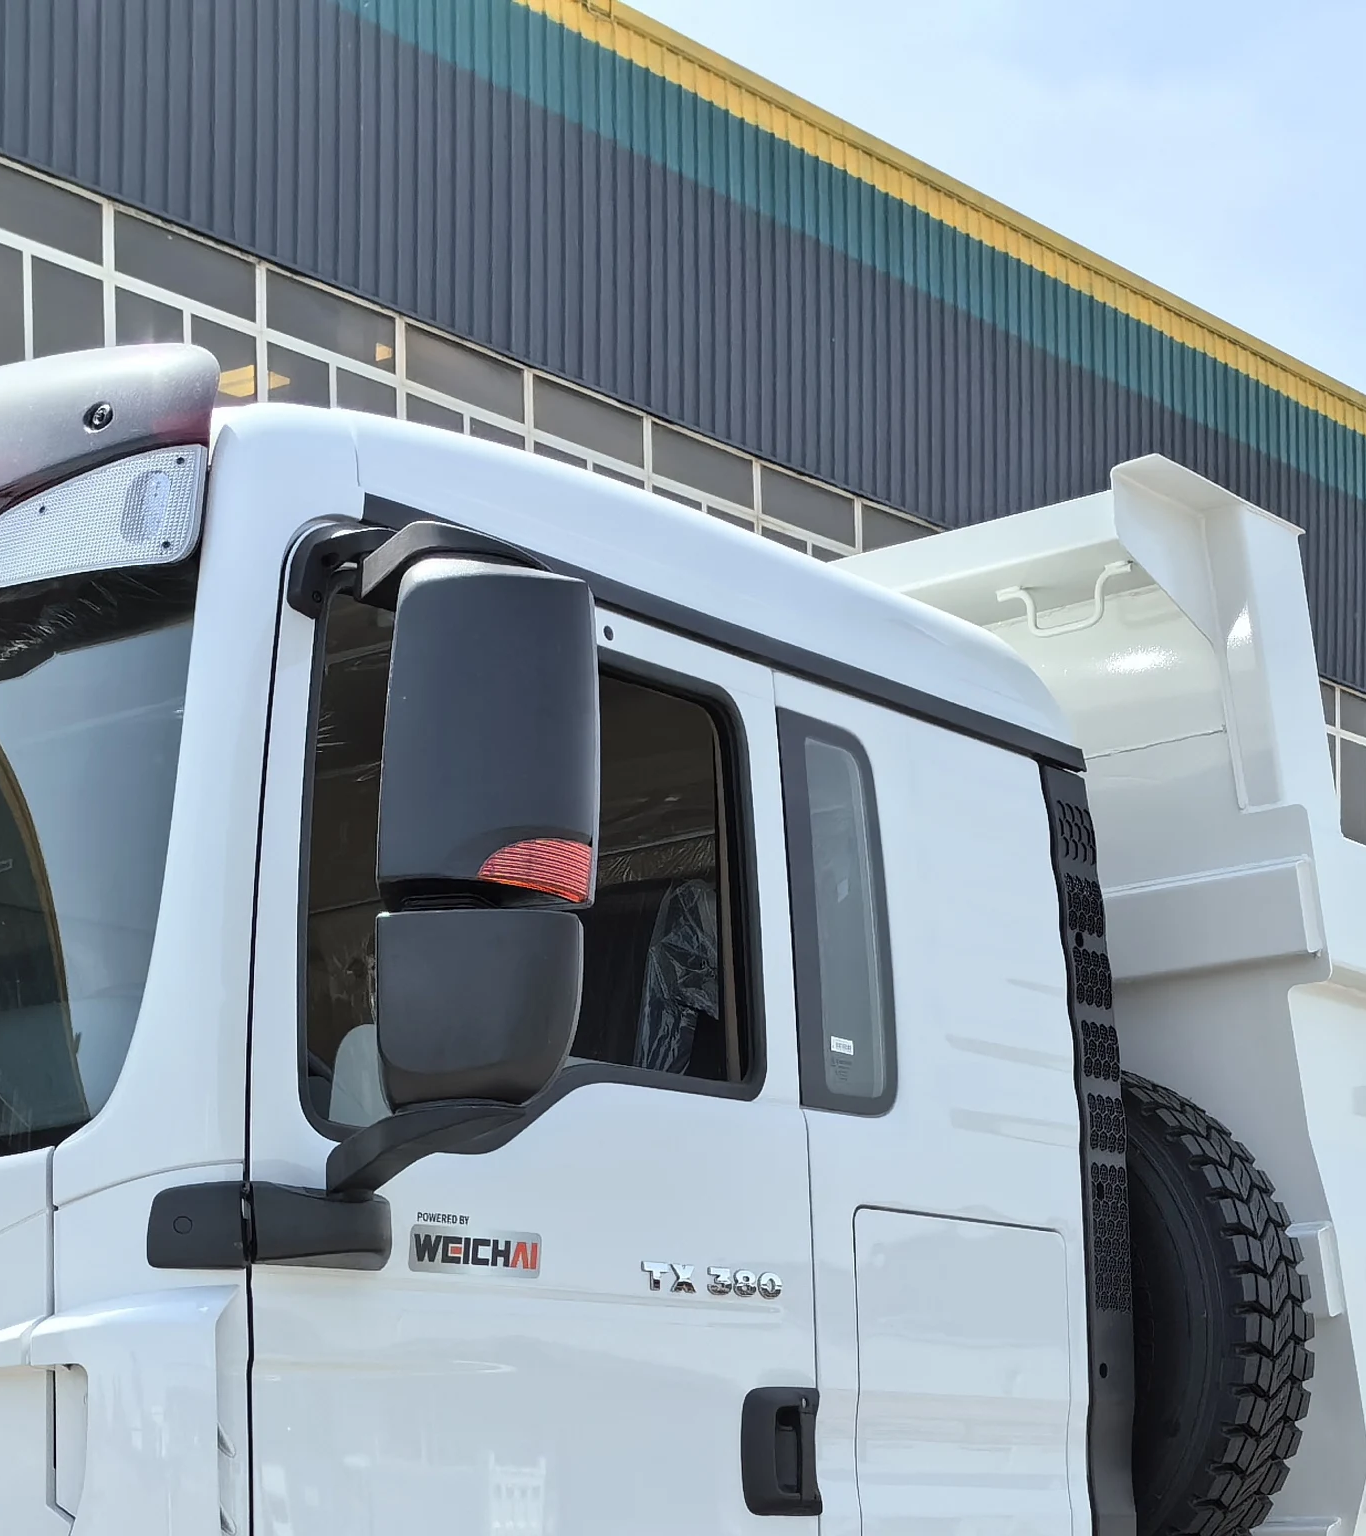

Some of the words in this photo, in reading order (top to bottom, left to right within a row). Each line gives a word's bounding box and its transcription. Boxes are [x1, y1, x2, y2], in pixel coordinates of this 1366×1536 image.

[417, 1212, 457, 1224] POWERED
[459, 1215, 470, 1225] BY
[414, 1233, 538, 1270] WEICHAI
[641, 1261, 696, 1293] TX
[707, 1266, 783, 1299] 380
